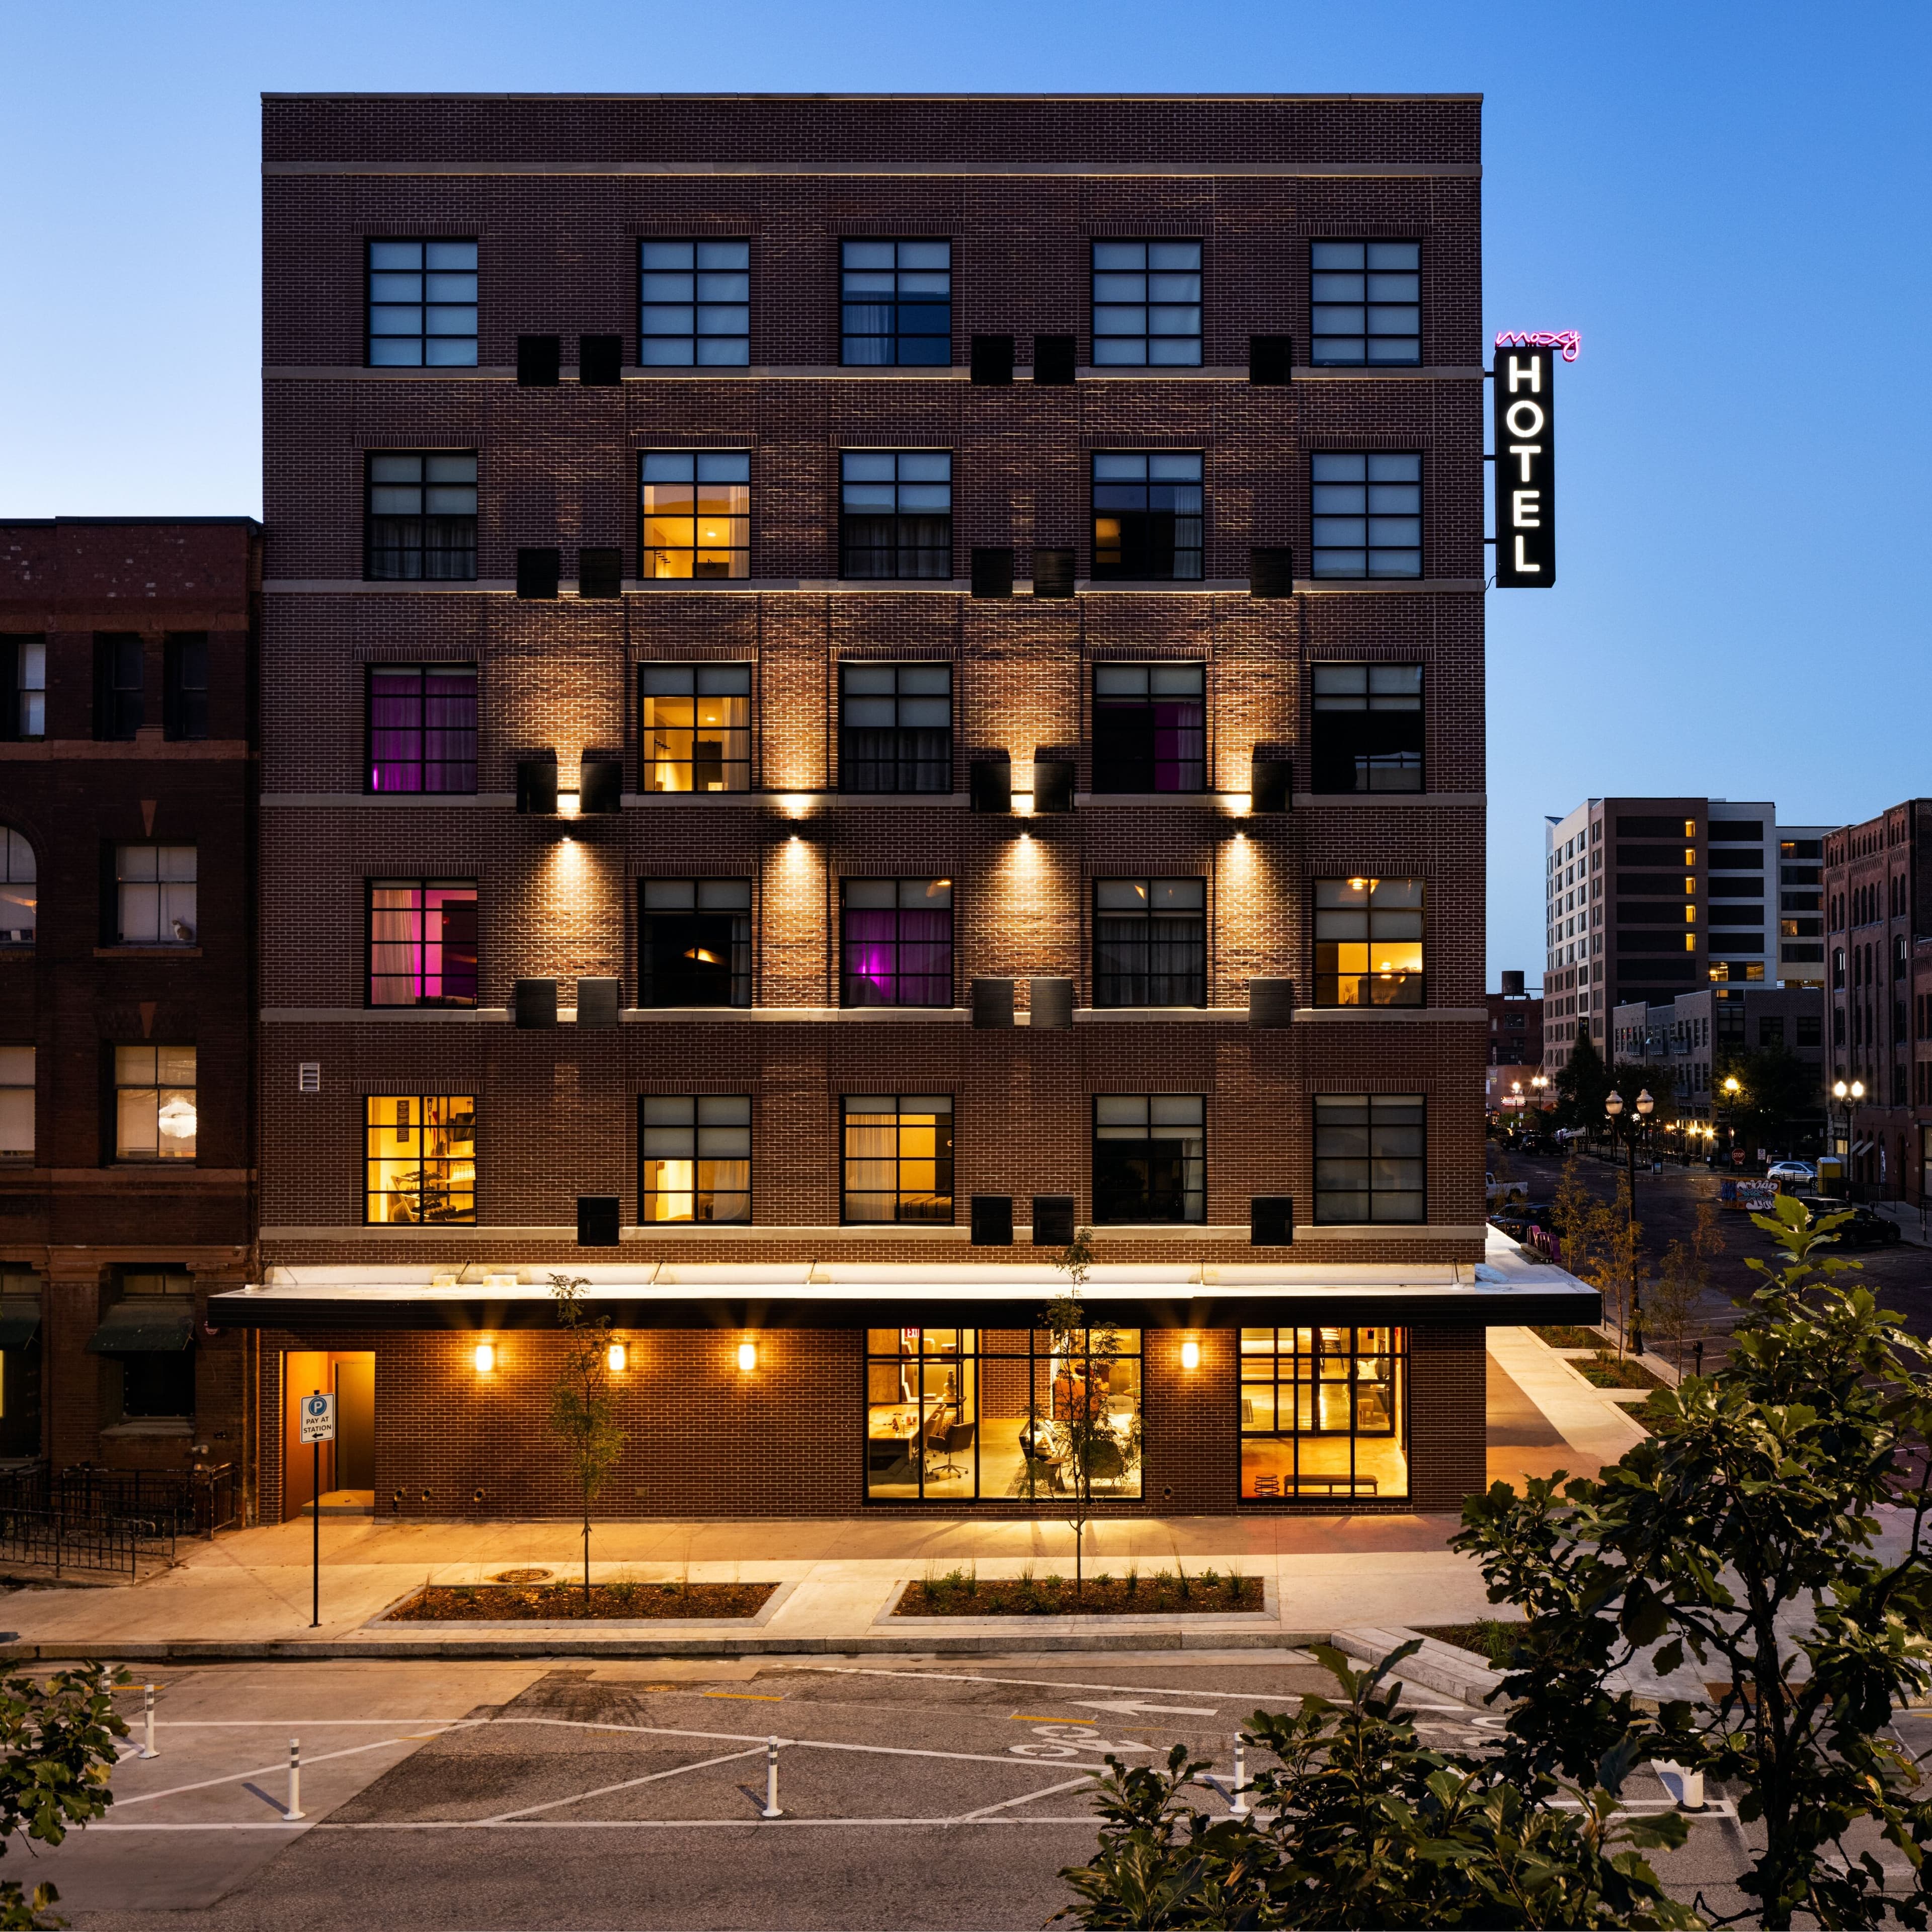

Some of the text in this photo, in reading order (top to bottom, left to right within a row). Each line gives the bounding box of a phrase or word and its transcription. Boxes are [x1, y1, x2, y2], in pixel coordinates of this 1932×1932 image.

[1496, 330, 1581, 362] moxy
[1506, 356, 1544, 572] HOTEL
[314, 1401, 323, 1413] P
[303, 1424, 332, 1433] STATION
